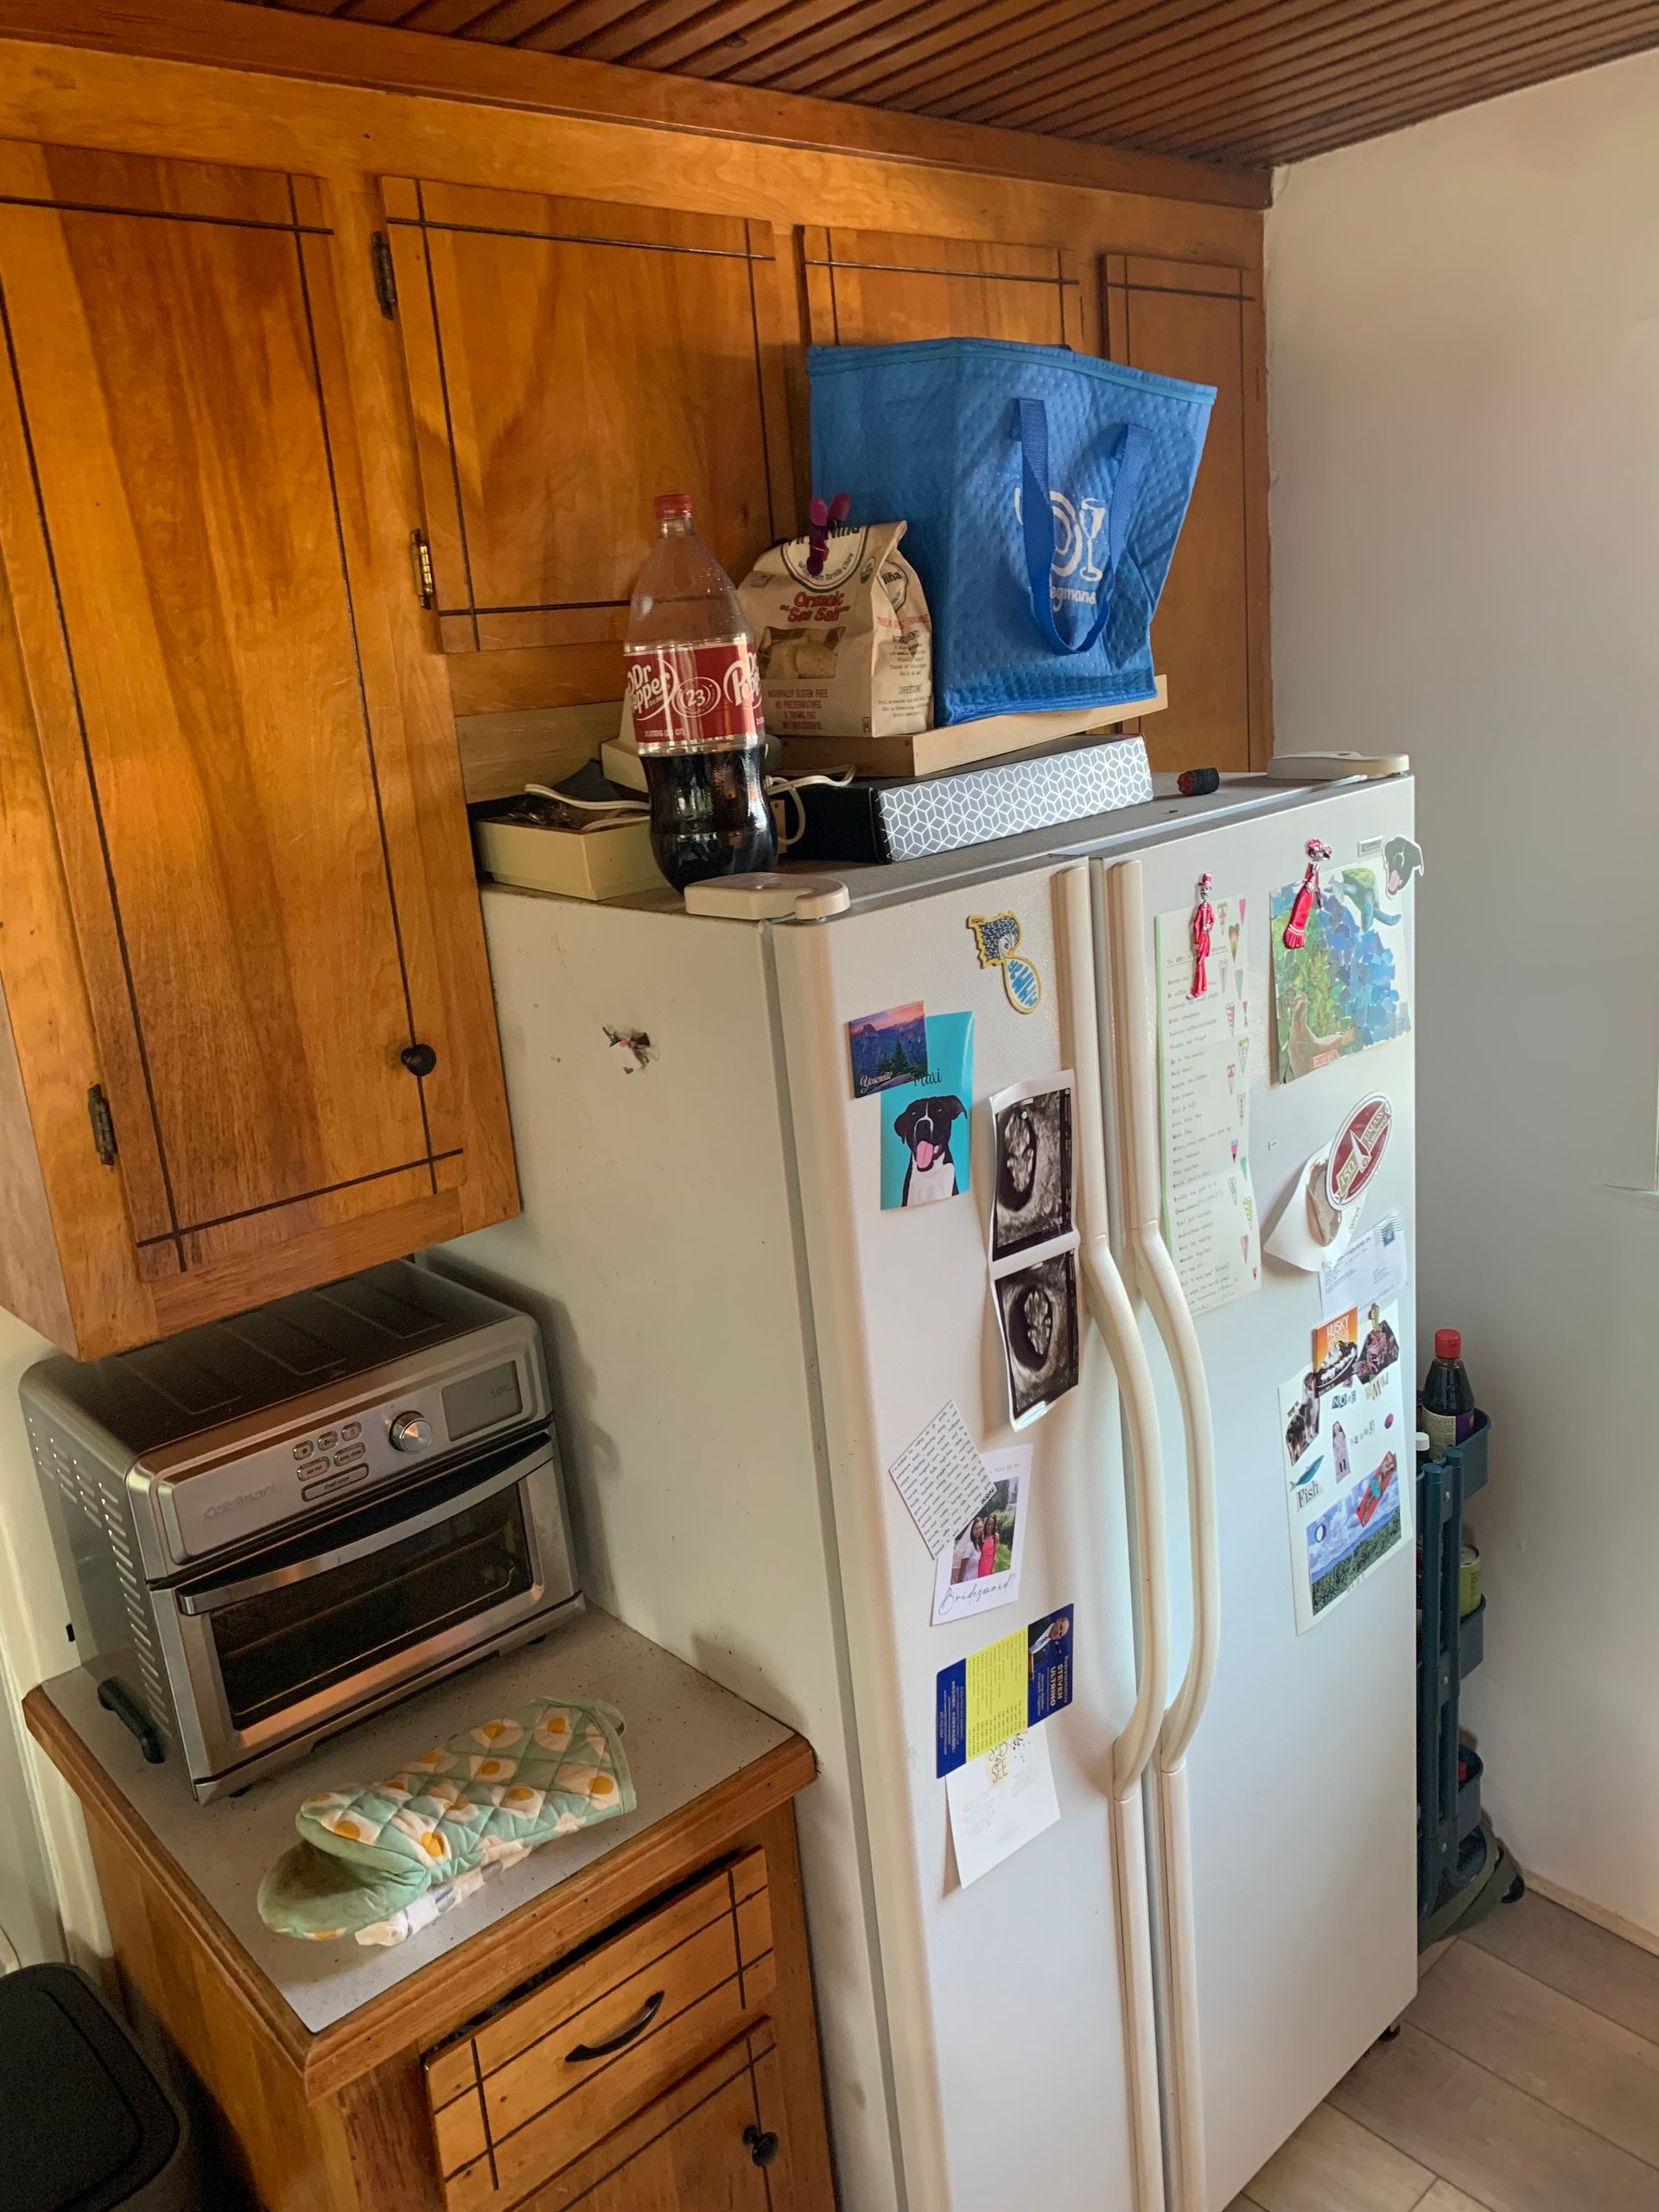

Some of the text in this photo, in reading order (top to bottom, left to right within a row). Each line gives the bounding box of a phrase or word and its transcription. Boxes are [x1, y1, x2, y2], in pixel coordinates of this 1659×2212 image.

[794, 591, 845, 608] Organic
[1049, 586, 1096, 613] egmans
[685, 689, 707, 707] 23
[1340, 1160, 1356, 1185] 150
[1326, 1314, 1349, 1339] HUSKY
[1298, 1480, 1319, 1508] Fish
[938, 1572, 1017, 1616] Bridesmaid?
